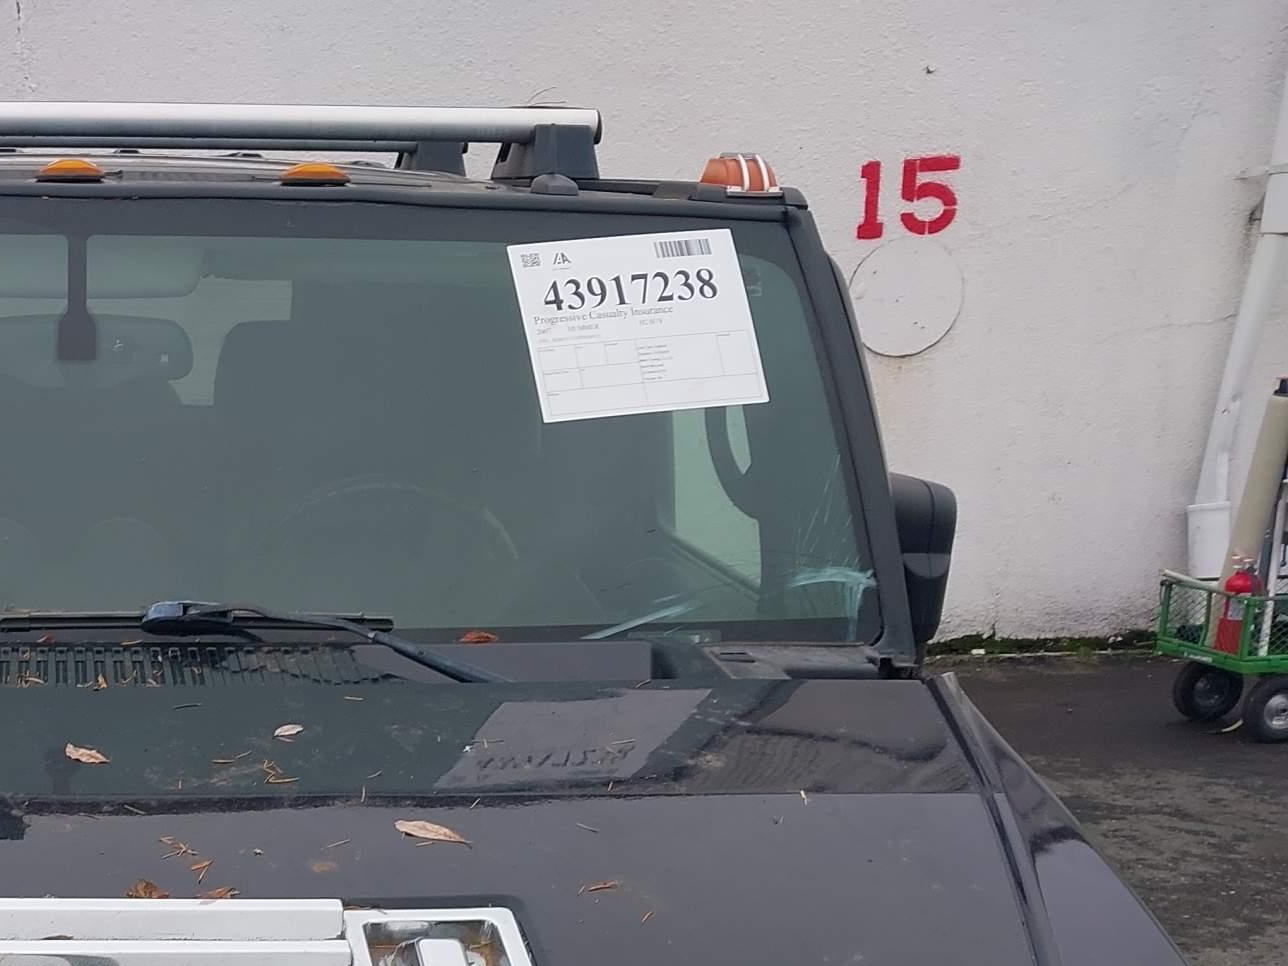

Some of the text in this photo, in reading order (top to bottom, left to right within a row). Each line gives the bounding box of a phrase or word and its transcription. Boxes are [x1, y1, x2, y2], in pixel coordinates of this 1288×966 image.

[857, 155, 960, 240] 15
[544, 268, 718, 312] 43917238
[534, 305, 674, 326] Progressive Casualty Insurance
